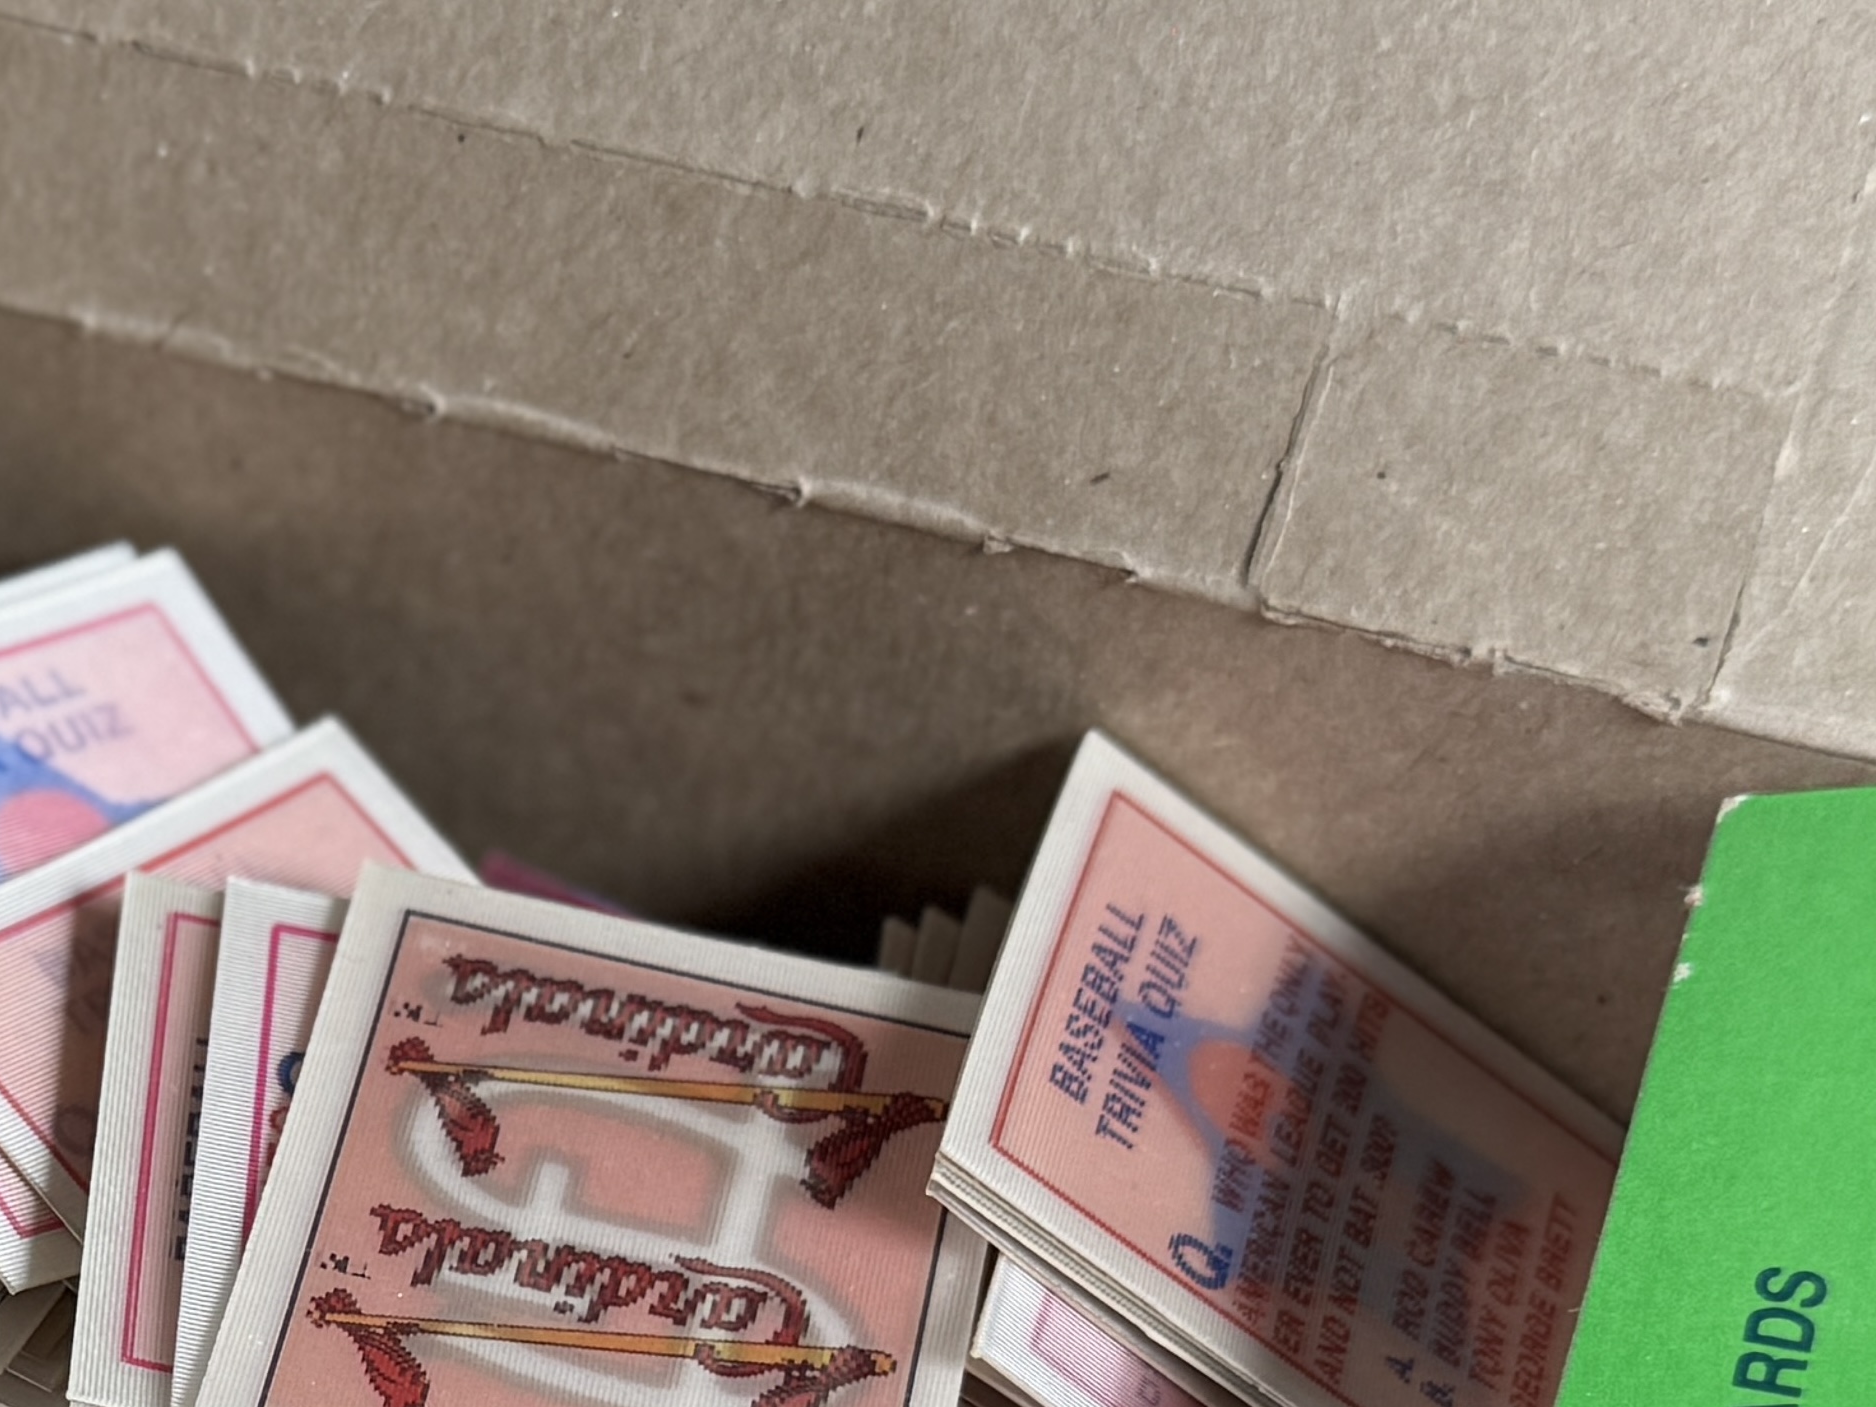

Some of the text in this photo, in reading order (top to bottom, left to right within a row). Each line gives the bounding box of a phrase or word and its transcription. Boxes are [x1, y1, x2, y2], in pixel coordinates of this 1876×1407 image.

[12, 702, 135, 764] QUIZ
[445, 954, 865, 1112] Cardinals
[1050, 902, 1145, 1105] BASEBALL
[1095, 914, 1198, 1150] TRIVIA QUIZ
[1347, 990, 1391, 1065] HITS
[1229, 1071, 1272, 1142] WAS
[1315, 1114, 1353, 1178] GET
[1211, 1137, 1256, 1214] WHO
[1231, 1167, 1291, 1326] AMERICAN
[1270, 1047, 1324, 1168] LEAGUE
[1301, 1179, 1336, 1224] TO
[1404, 1156, 1456, 1268] CAREW
[1342, 1185, 1377, 1249] BAT
[1449, 1186, 1498, 1265] BELL
[1534, 1191, 1577, 1294] BRETT
[371, 1204, 811, 1376] Cardinals
[1282, 1226, 1323, 1308] EVER
[1327, 1244, 1364, 1317] NOT
[1484, 1218, 1531, 1307] OLIVA
[1273, 1308, 1306, 1354] ER
[1390, 1266, 1430, 1343] ROD
[1429, 1256, 1472, 1370] BUDDY
[1314, 1314, 1351, 1386] AND
[1467, 1304, 1508, 1393] TONY
